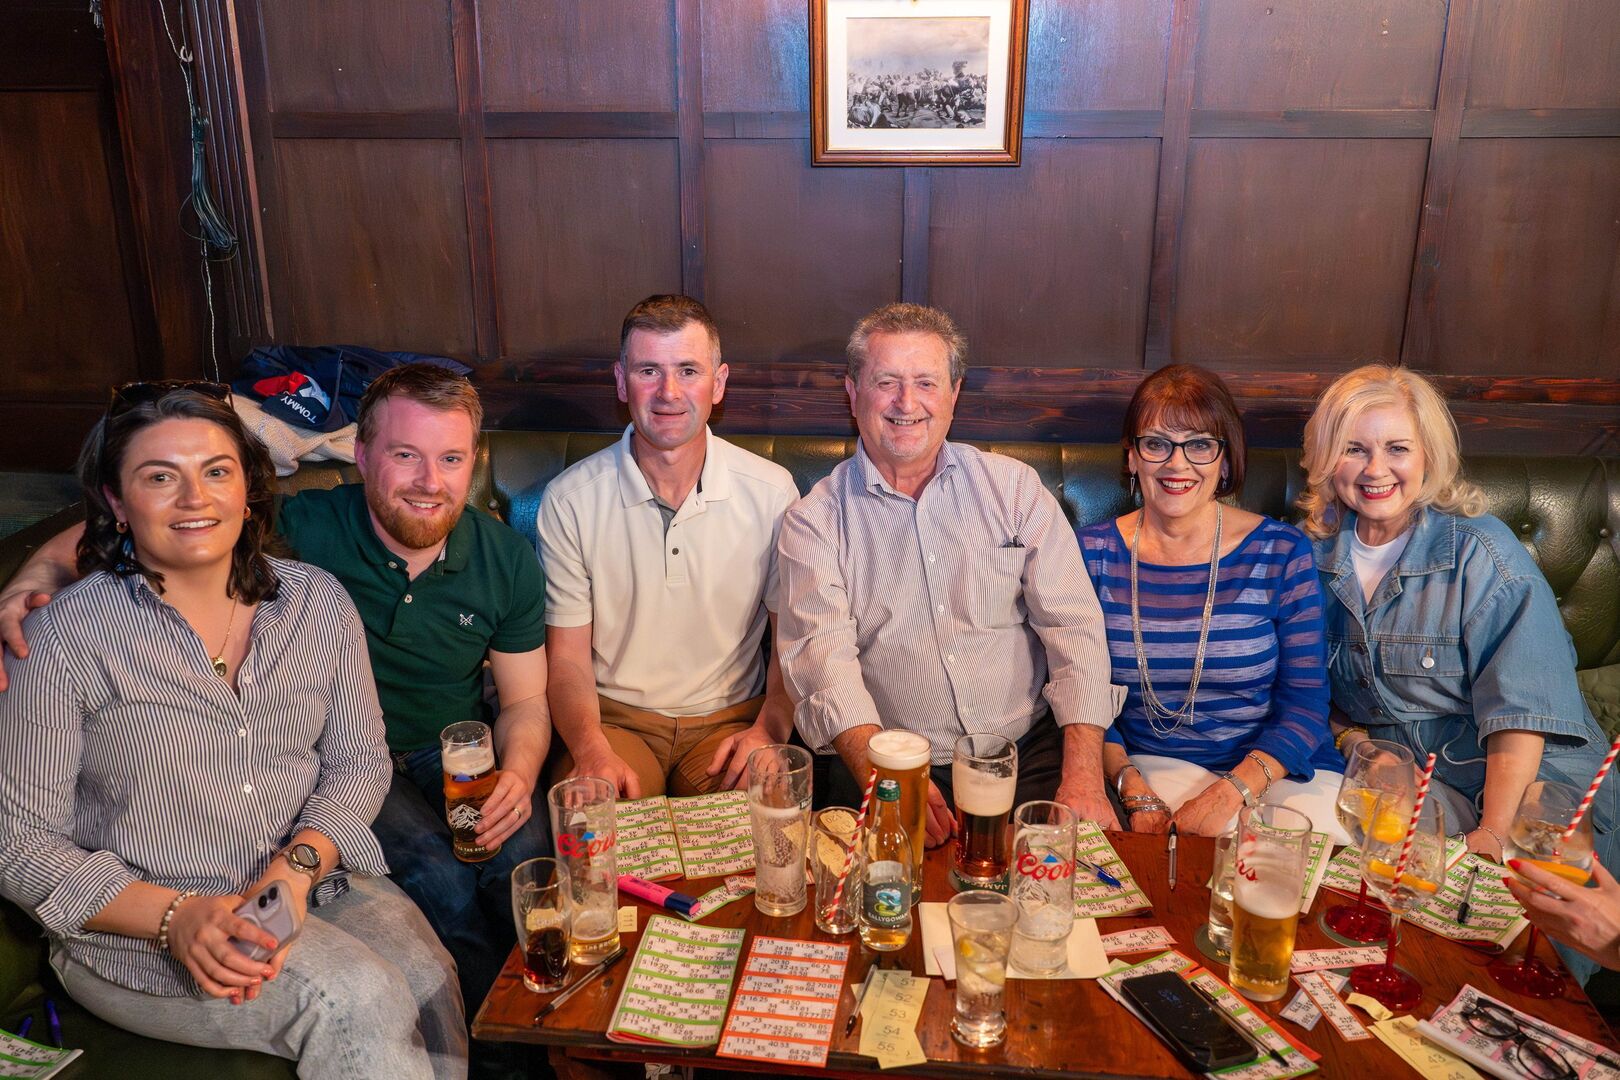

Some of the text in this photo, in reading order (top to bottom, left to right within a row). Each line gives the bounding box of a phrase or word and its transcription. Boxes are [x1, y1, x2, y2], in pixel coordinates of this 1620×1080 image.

[280, 395, 317, 424] TOMMY
[895, 993, 912, 1002] 52
[889, 1009, 906, 1018] 53
[883, 1025, 900, 1035] 54
[877, 1041, 895, 1051] 55
[1428, 1054, 1446, 1063] 43
